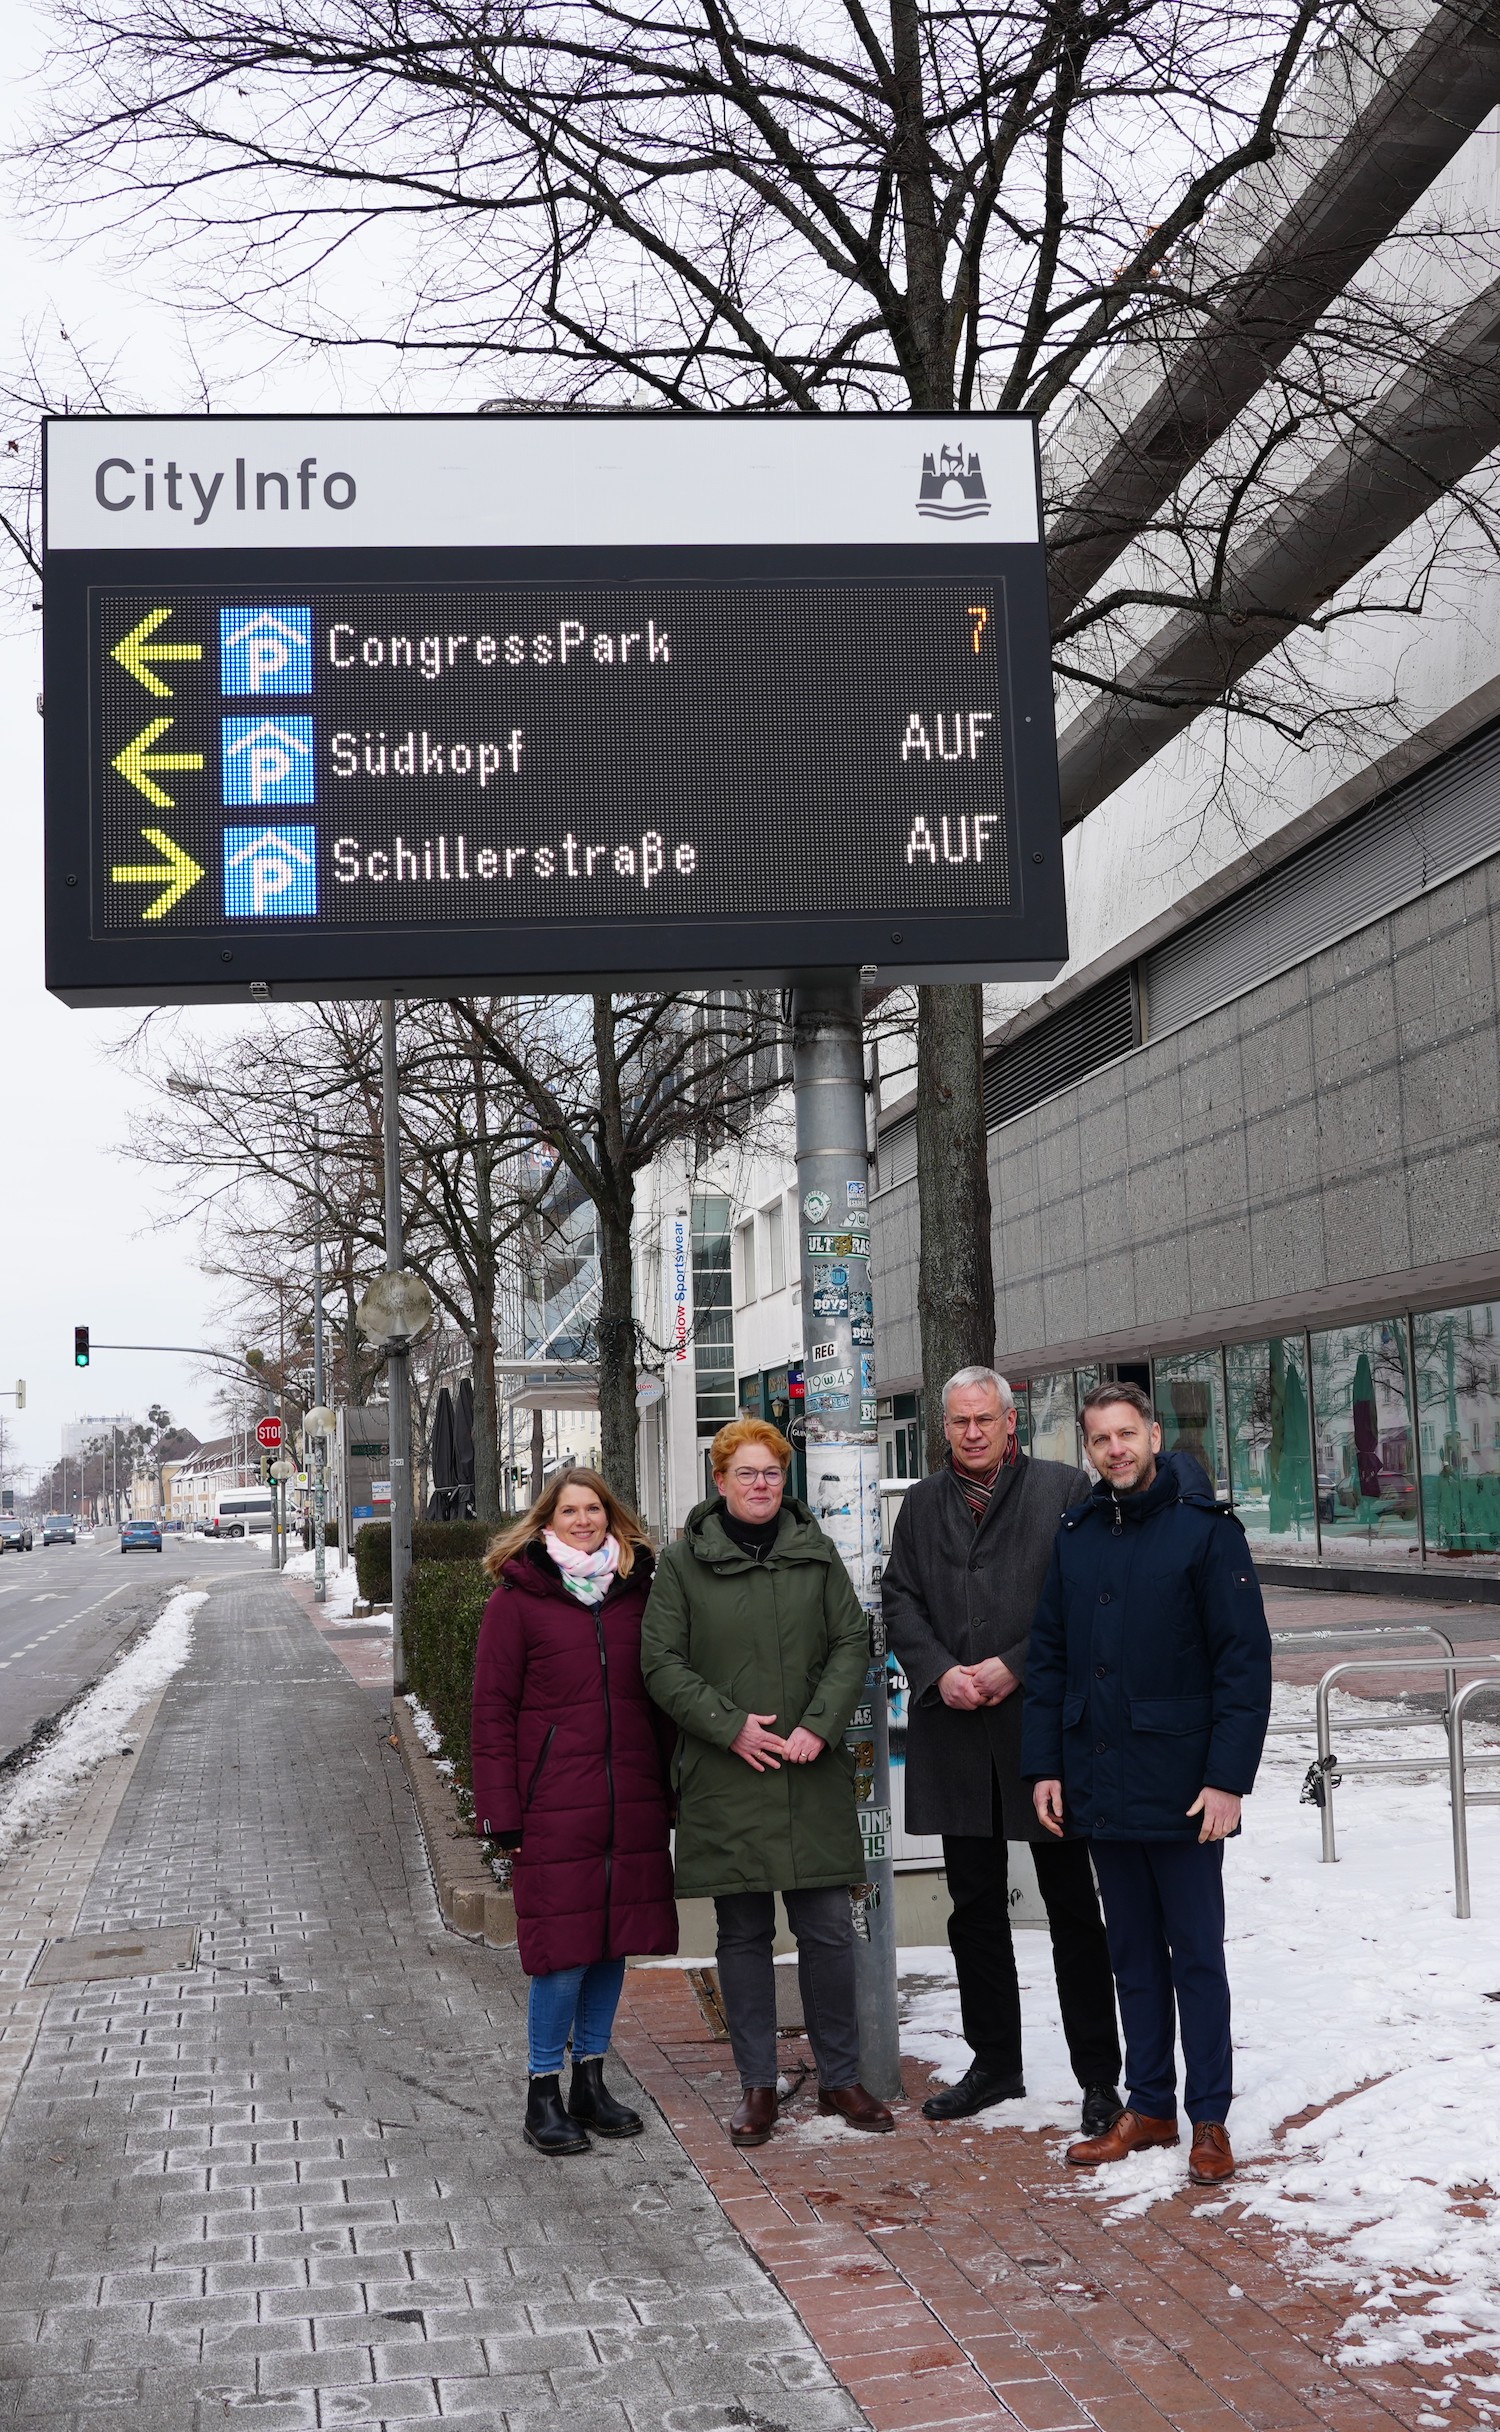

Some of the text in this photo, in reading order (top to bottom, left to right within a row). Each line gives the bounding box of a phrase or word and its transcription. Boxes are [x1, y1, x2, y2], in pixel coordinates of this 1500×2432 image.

[95, 457, 357, 525] CityInfo
[328, 620, 671, 679] CongressPark
[967, 606, 988, 654] 7
[331, 729, 524, 787] Südkopf
[901, 712, 993, 762] AUF
[333, 831, 698, 889] Schillerstraße
[907, 815, 998, 865] AUF
[674, 1222, 688, 1301] Sportswear
[813, 1298, 848, 1311] BOYS
[815, 1343, 835, 1360] REG
